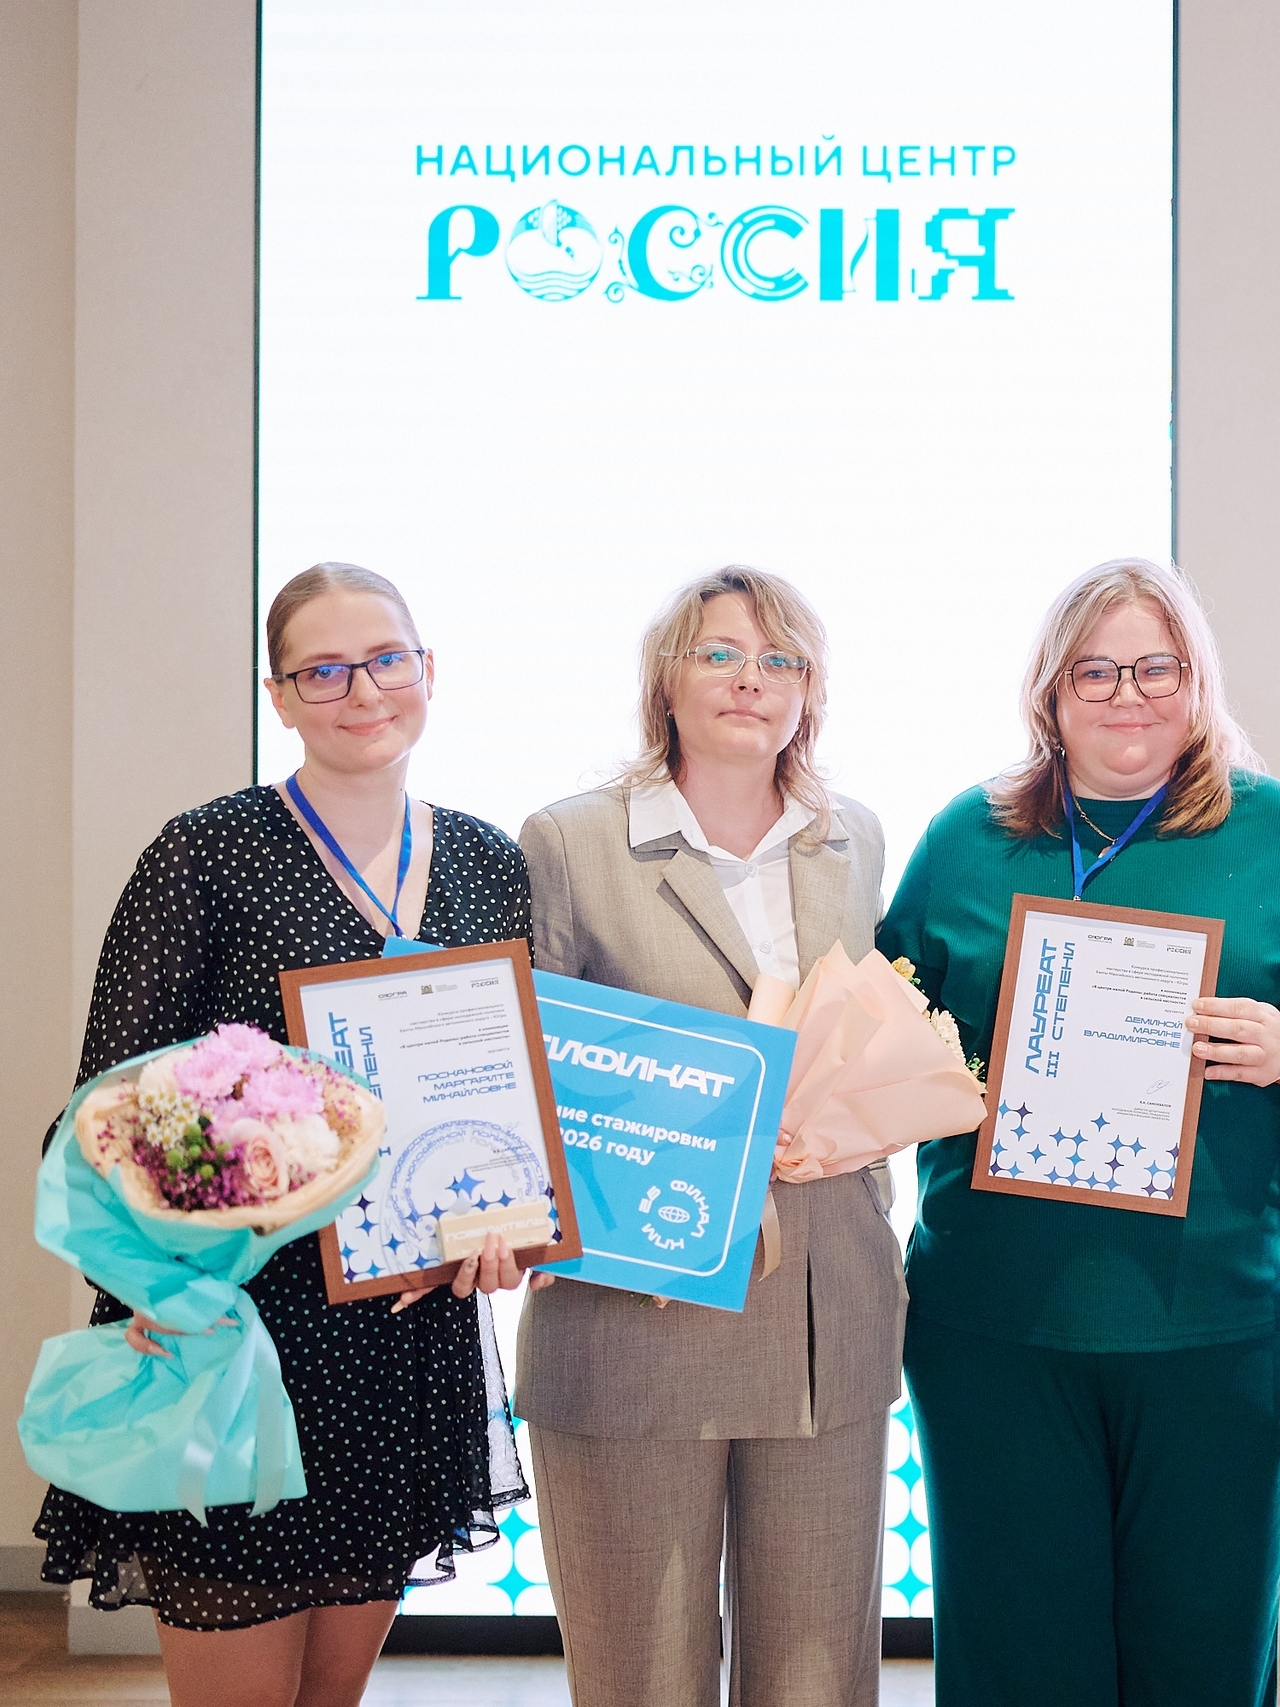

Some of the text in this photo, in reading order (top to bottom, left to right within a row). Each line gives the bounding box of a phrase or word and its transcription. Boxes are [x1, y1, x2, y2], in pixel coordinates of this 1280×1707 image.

[416, 134, 1016, 183] НАЦИОНАЛЬНЫЙ ЦЕНТР
[416, 199, 1016, 303] РОССИЯ
[1024, 938, 1058, 1074] ЛАУРЕАТ
[1046, 942, 1076, 1078] III СТЕПЕНИ
[1125, 1014, 1183, 1029] ДЕМИНОЙ
[1084, 1030, 1181, 1049] ВЛАДИМИРОВНЕ
[1133, 1026, 1182, 1039] МАРИНЕ
[359, 1026, 383, 1101] ЕПЕНИ
[433, 1071, 515, 1092] МАРГАРИТЕ
[542, 1034, 735, 1097] ИФИКАТ
[422, 1080, 517, 1104] МИХАЙЛОВНЕ
[591, 1113, 717, 1151] стажировки
[606, 1141, 655, 1166] году
[670, 1180, 709, 1238] ФИНАЛ
